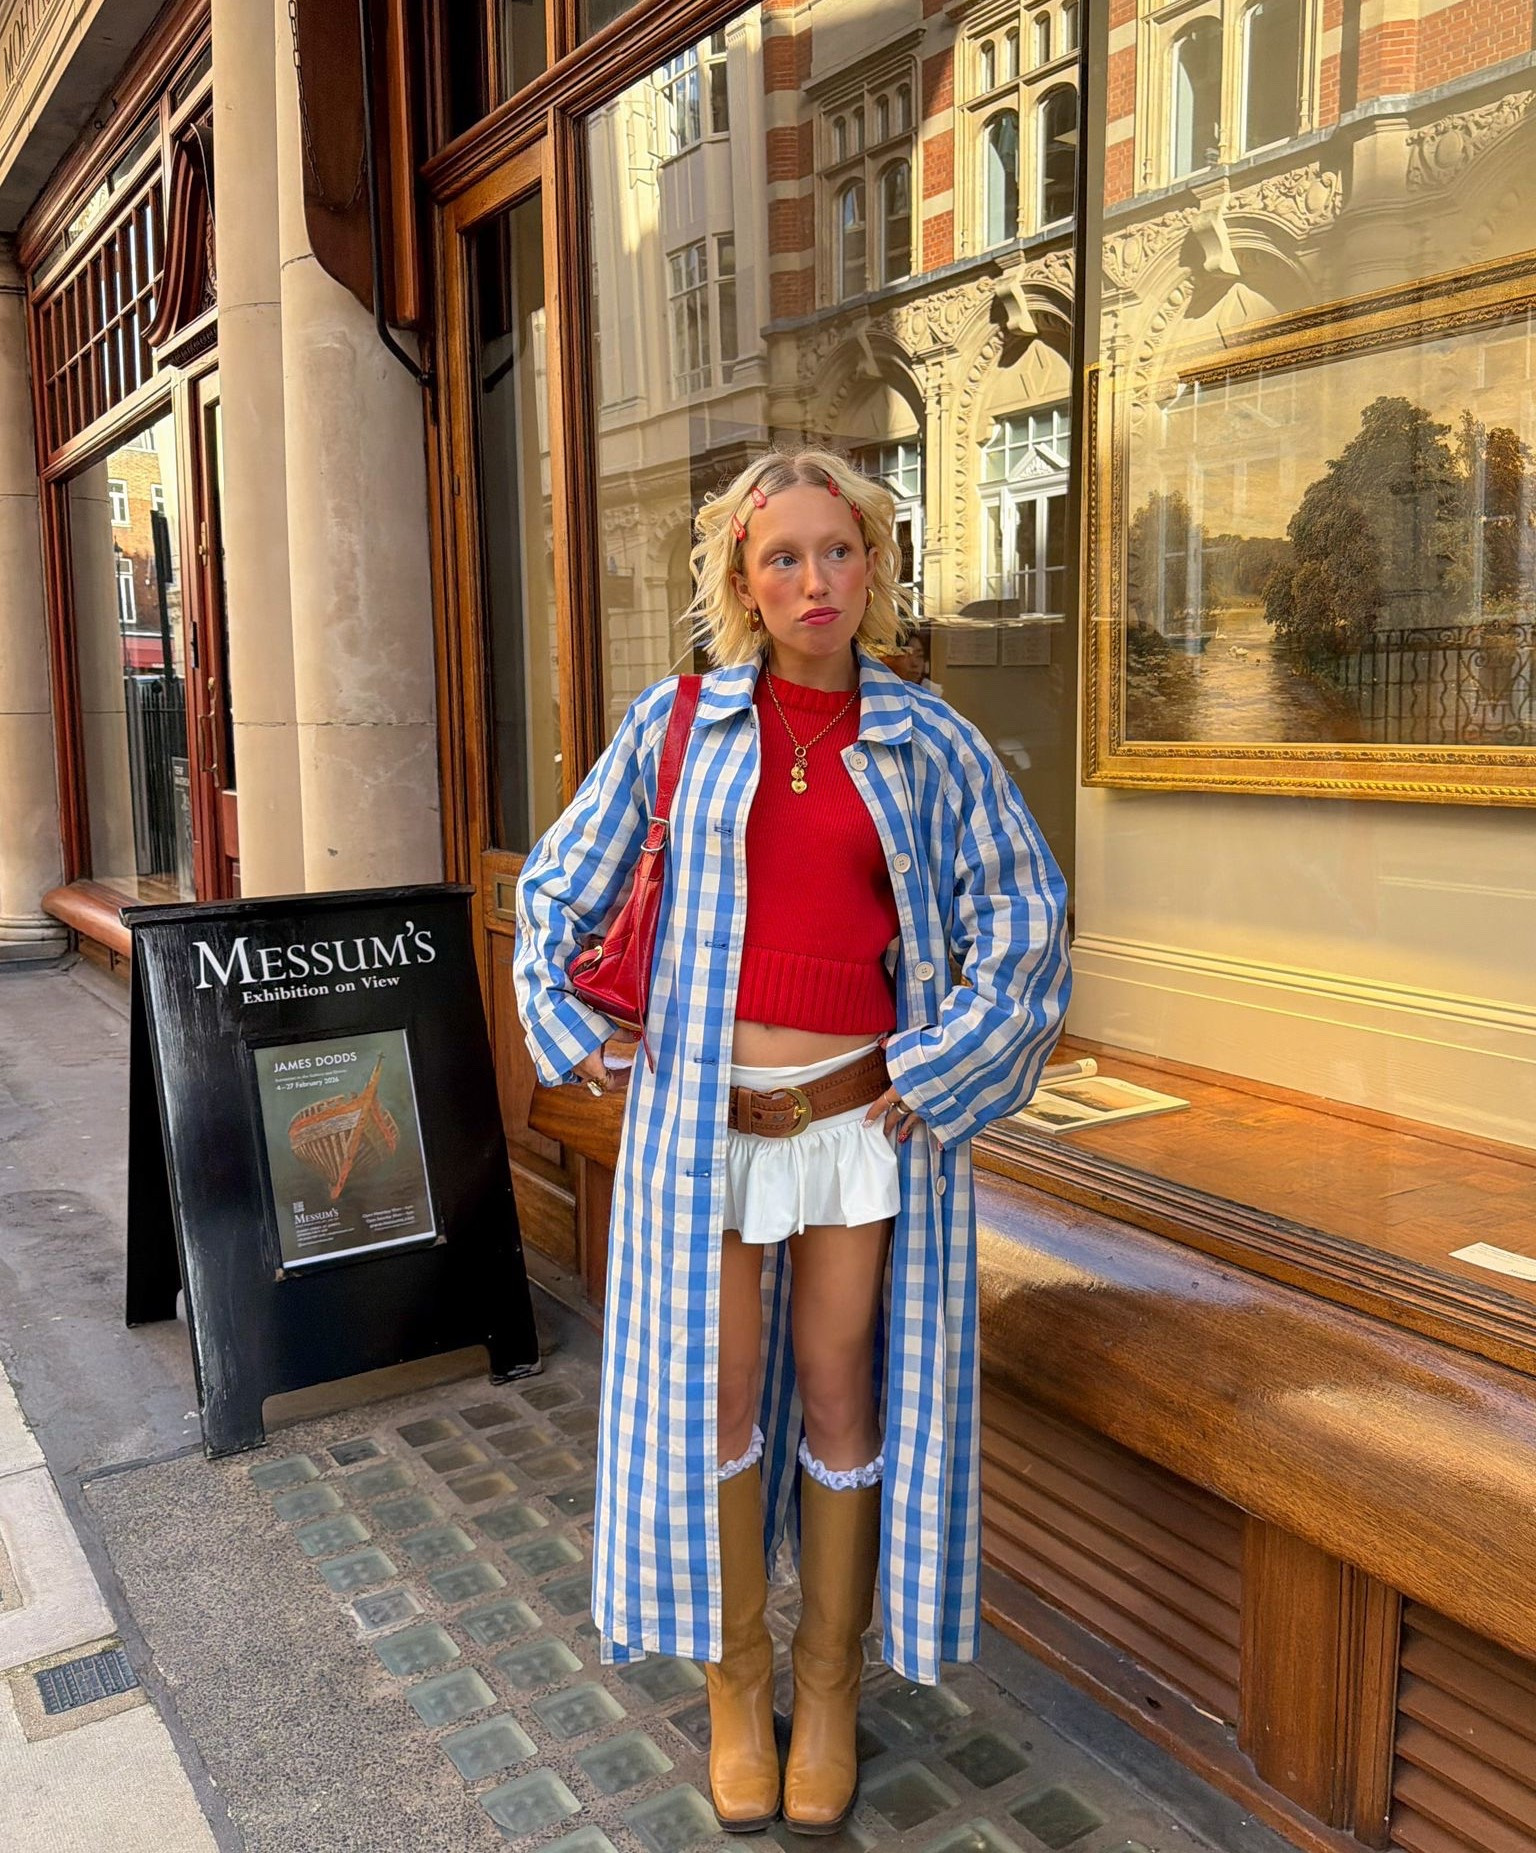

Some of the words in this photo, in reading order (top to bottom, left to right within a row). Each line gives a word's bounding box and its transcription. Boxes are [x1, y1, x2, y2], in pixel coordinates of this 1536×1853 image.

[192, 920, 437, 990] MESSUM'S
[242, 984, 329, 1005] Exhibition
[335, 980, 356, 993] on
[361, 974, 401, 990] View
[273, 1058, 312, 1073] JAMES
[315, 1052, 358, 1067] DODDS
[295, 1079, 323, 1089] February
